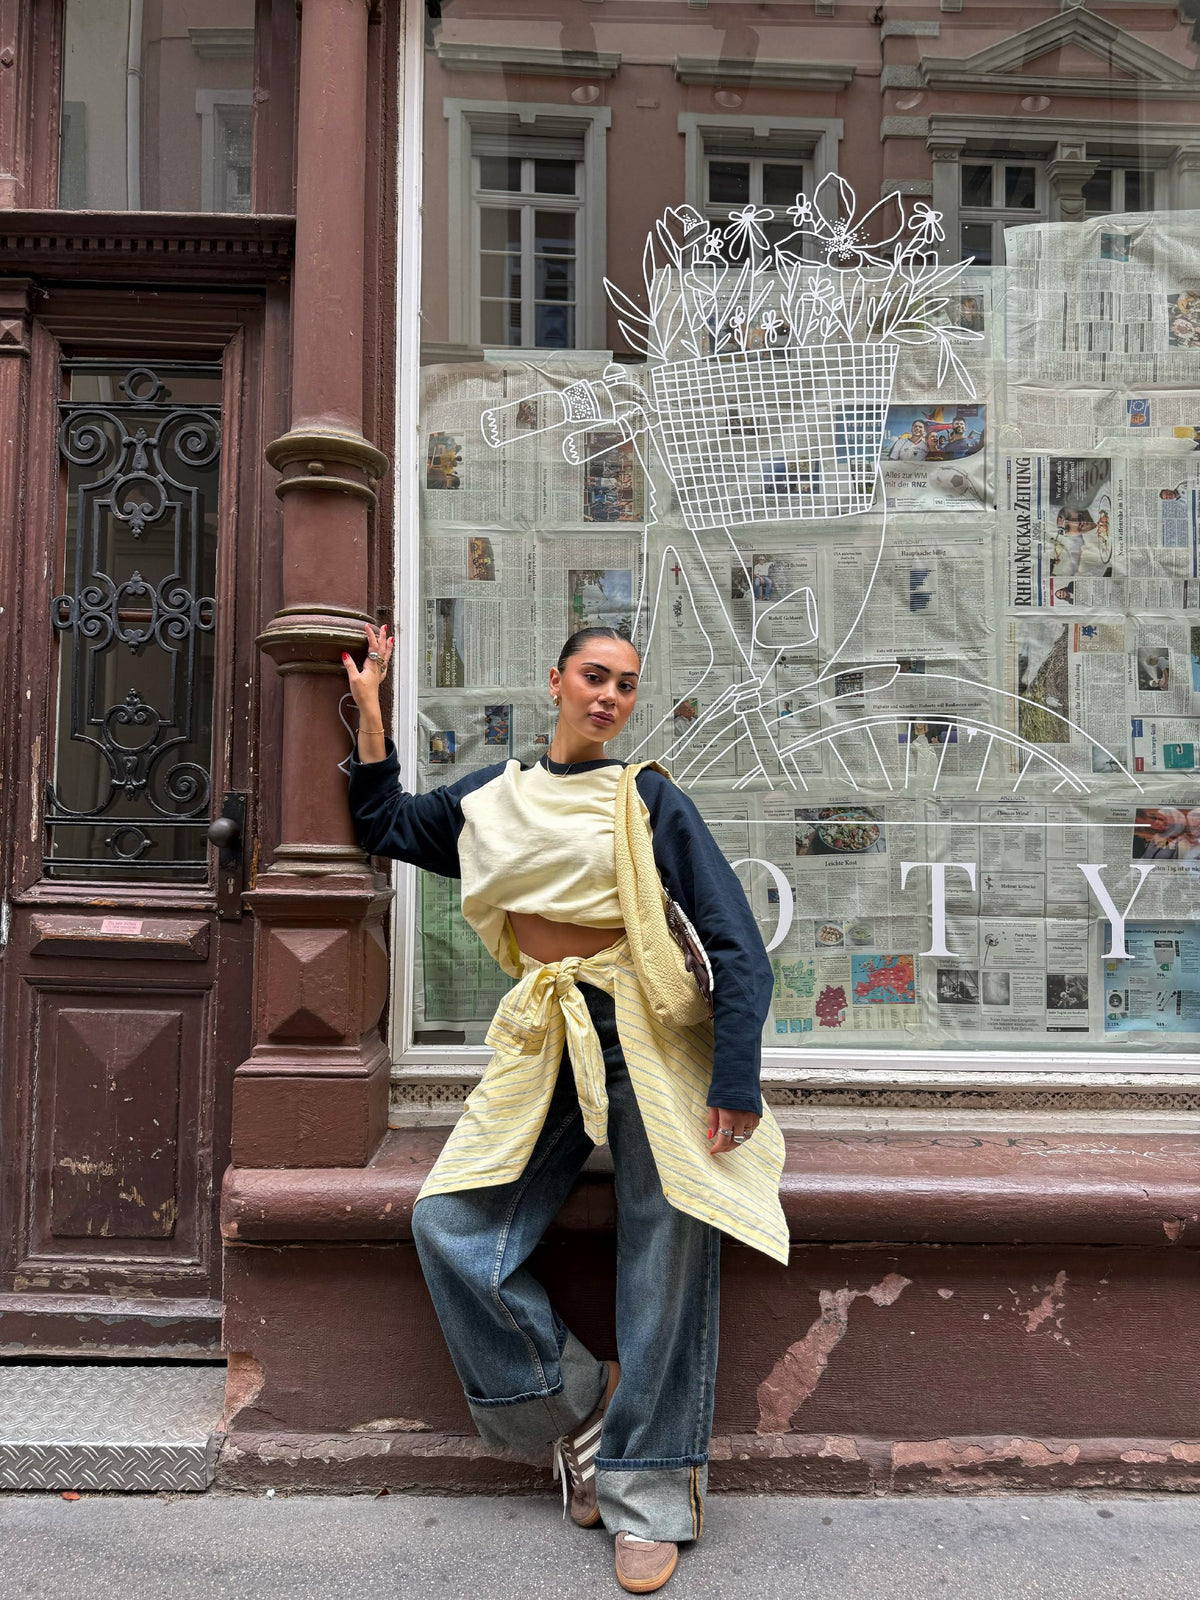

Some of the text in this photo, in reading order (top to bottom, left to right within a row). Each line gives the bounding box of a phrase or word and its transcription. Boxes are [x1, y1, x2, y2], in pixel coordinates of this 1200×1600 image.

[885, 471, 900, 479] Alles
[913, 471, 928, 479] WM
[1014, 457, 1031, 607] RHEIN-NECKAR-ZEITUNG
